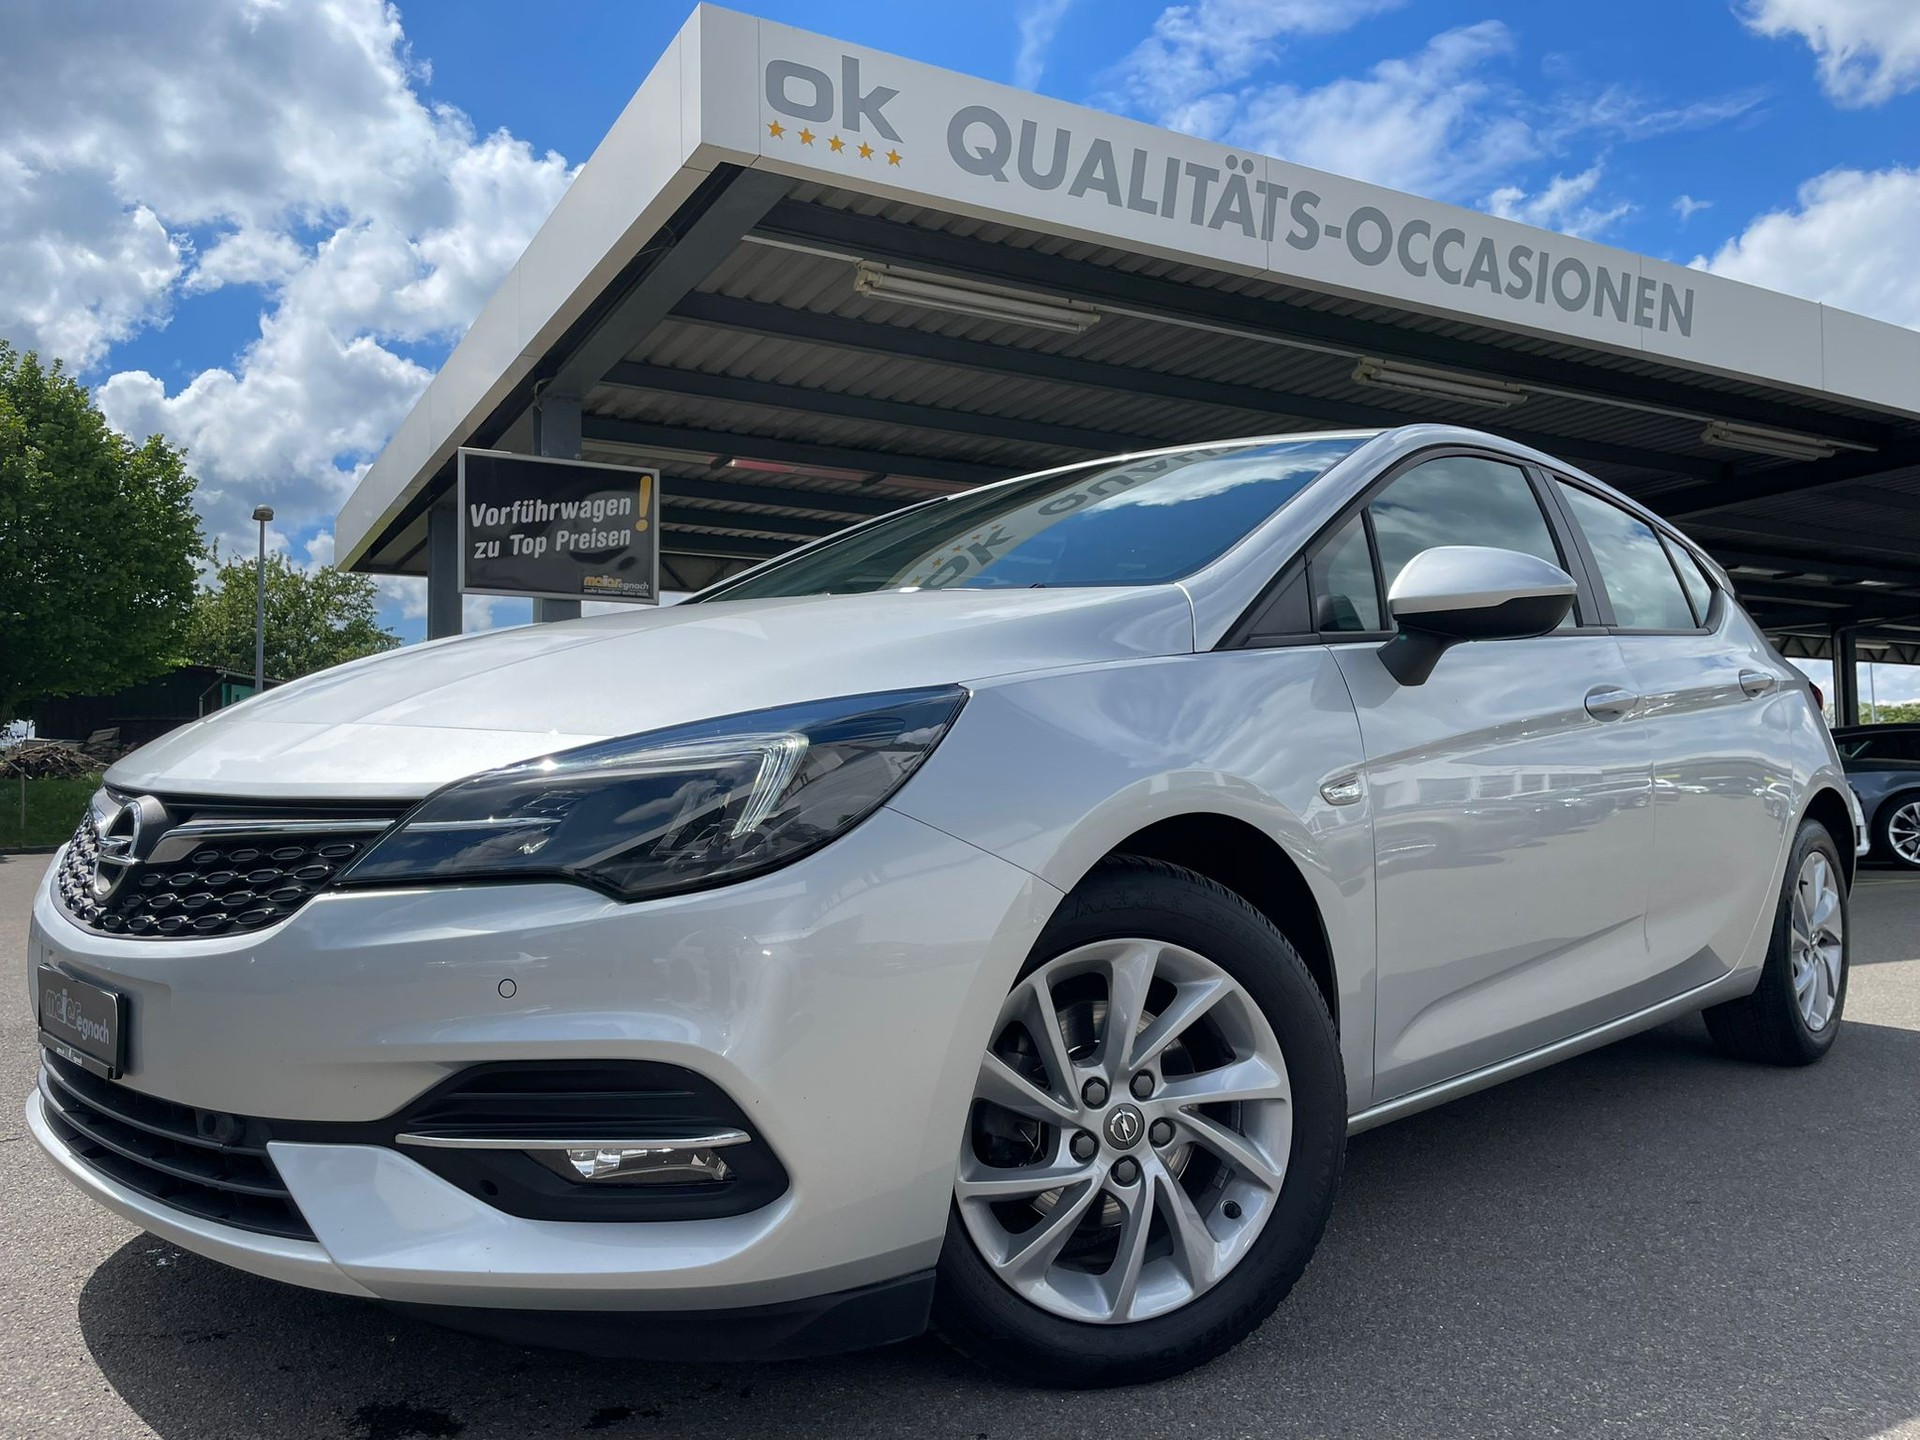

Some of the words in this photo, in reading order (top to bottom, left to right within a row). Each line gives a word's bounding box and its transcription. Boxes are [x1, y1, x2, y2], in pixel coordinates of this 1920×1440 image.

[765, 55, 904, 144] ok
[946, 105, 1695, 338] QUALITÄTS-OCCASIONEN
[470, 497, 631, 527] Vorführwagen
[473, 541, 500, 559] zu
[510, 534, 547, 559] Top
[556, 528, 631, 551] Preisen
[76, 1015, 110, 1045] egnach
